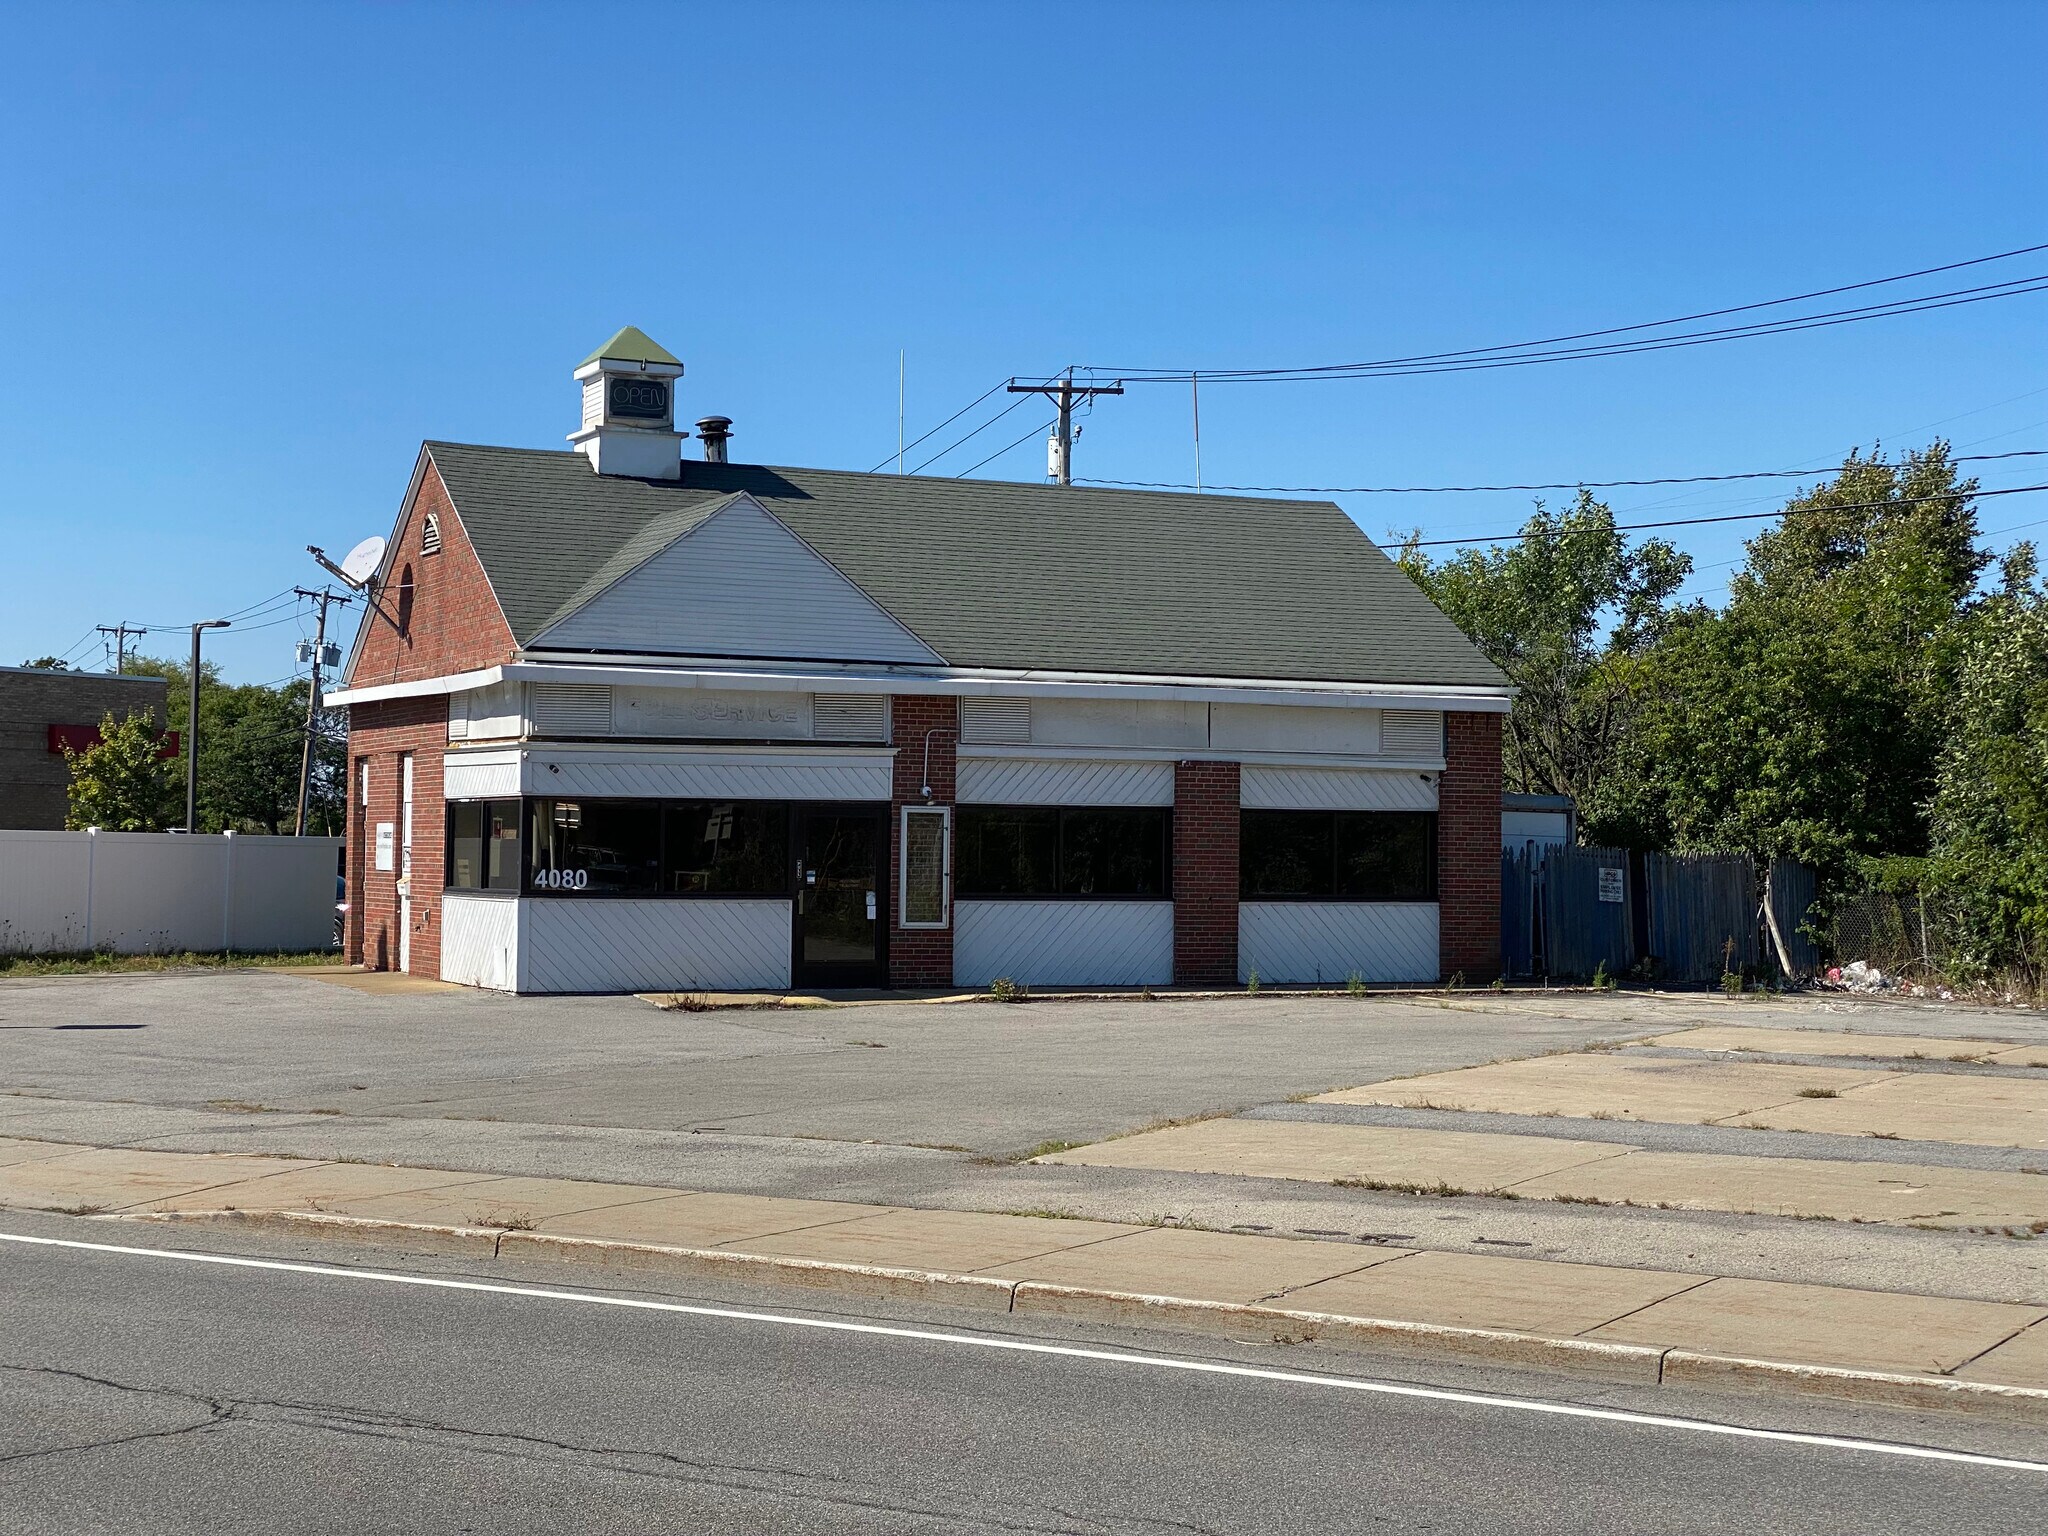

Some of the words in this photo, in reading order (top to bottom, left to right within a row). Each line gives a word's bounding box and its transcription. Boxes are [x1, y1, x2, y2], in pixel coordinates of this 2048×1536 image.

[613, 386, 665, 406] OPEN
[692, 698, 798, 723] SERVICE
[534, 869, 588, 888] 4080
